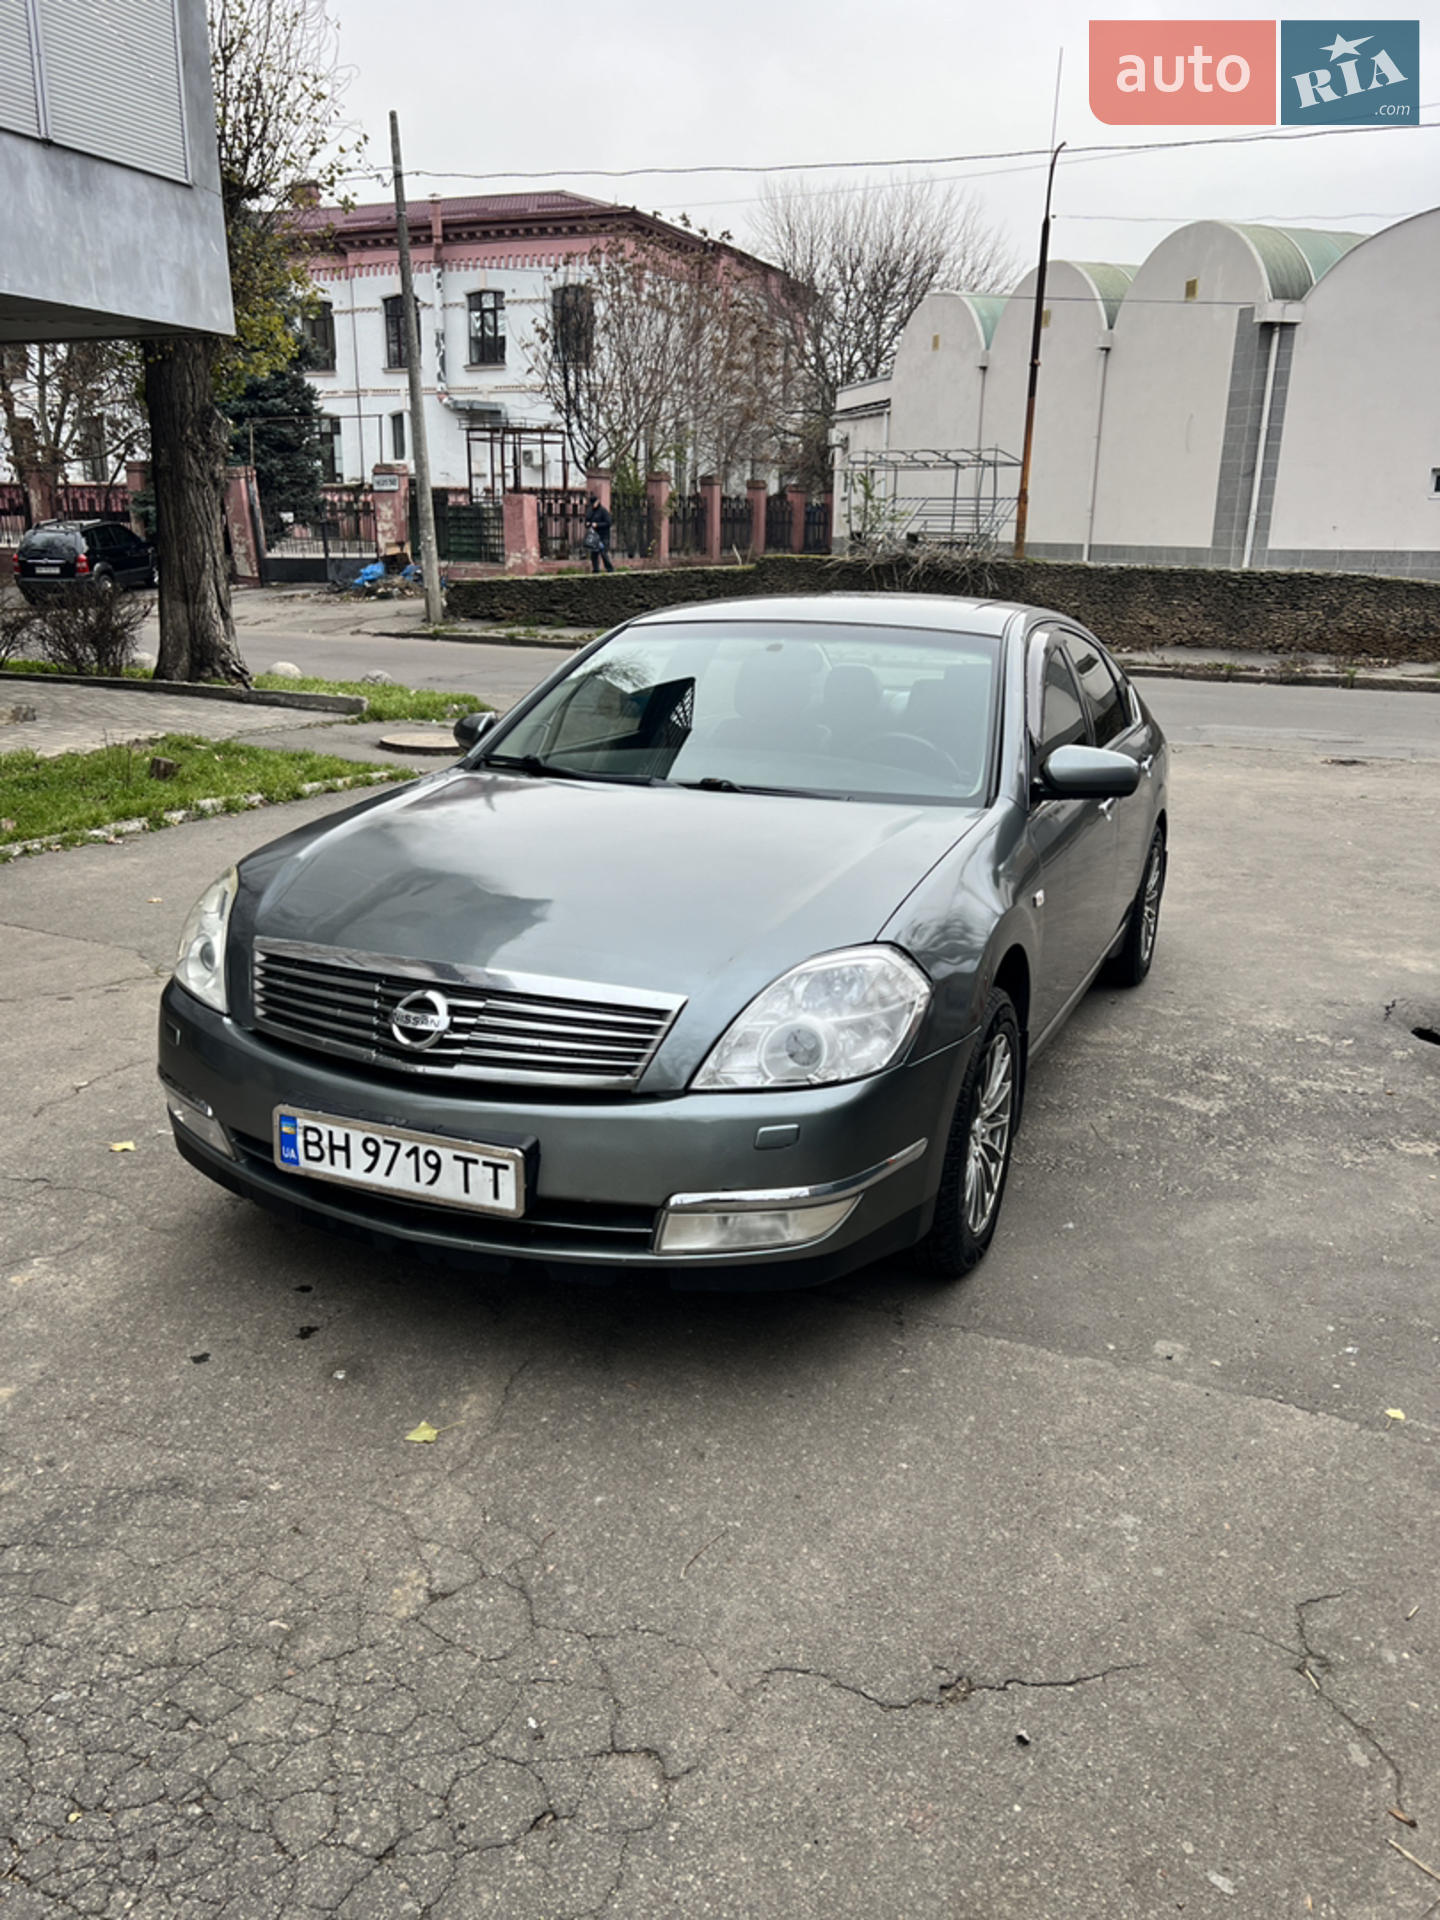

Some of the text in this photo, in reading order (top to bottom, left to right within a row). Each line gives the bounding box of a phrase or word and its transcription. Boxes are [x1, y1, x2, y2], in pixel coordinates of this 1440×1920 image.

[393, 1011, 441, 1029] NISSAN
[282, 1146, 298, 1160] UA
[303, 1125, 509, 1201] BH 9719 TT
